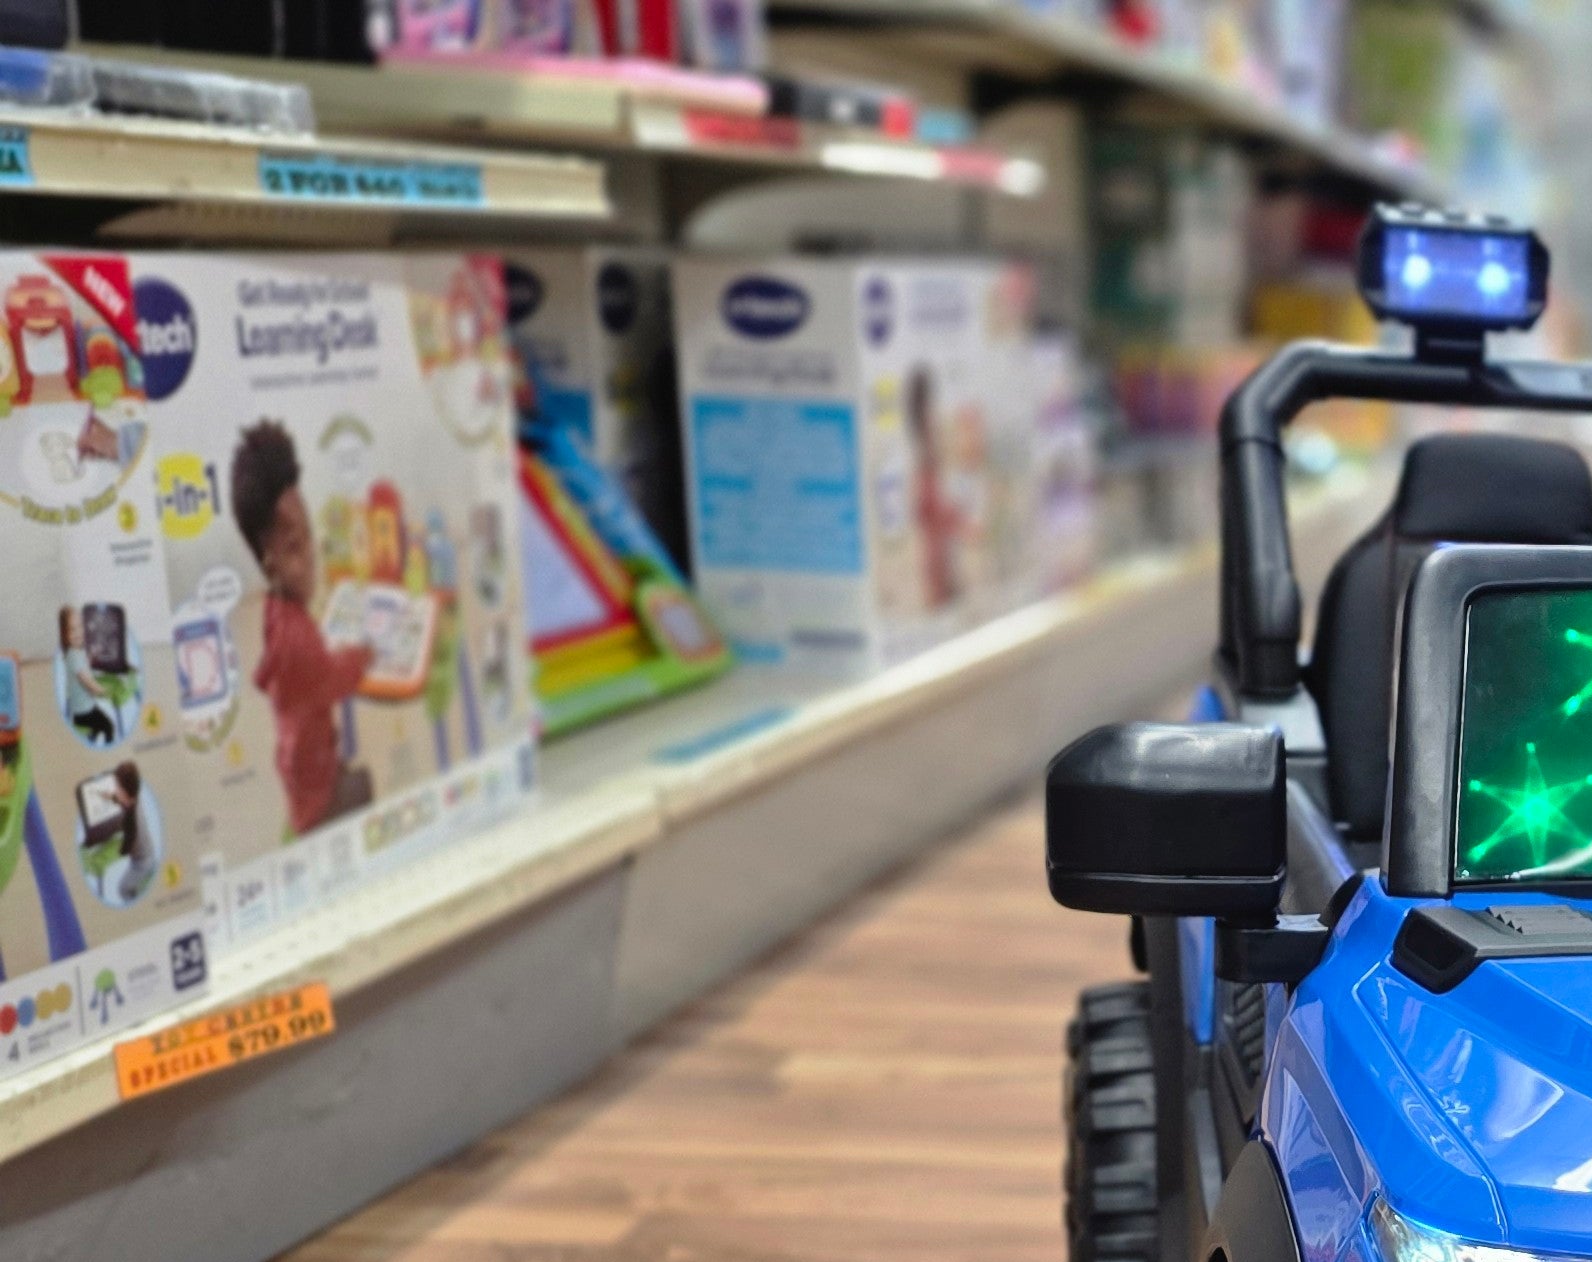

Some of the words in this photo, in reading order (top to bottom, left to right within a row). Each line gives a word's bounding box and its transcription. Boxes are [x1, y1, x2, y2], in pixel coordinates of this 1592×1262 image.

[235, 314, 329, 365] Learning
[130, 1046, 218, 1089] SPECIAL
[227, 1008, 326, 1058] $79.99
